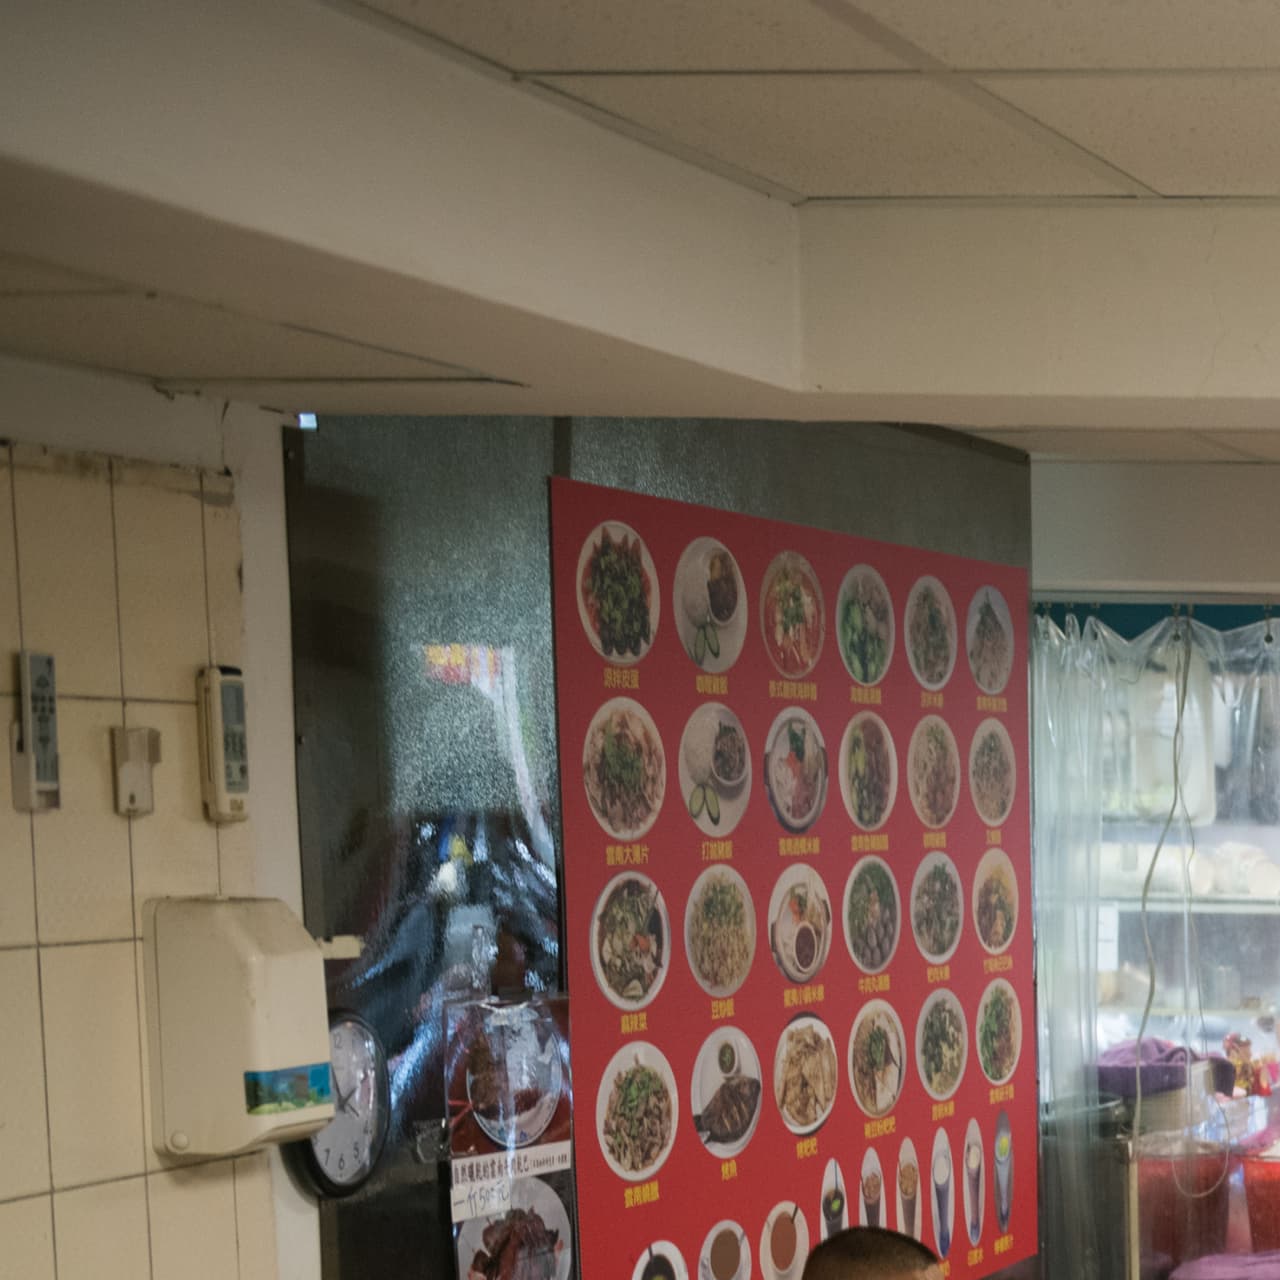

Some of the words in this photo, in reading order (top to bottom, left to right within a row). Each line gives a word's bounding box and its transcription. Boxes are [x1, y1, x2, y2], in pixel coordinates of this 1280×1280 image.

[323, 1148, 331, 1166] 7
[353, 1141, 361, 1160] 5
[338, 1152, 346, 1170] 6
